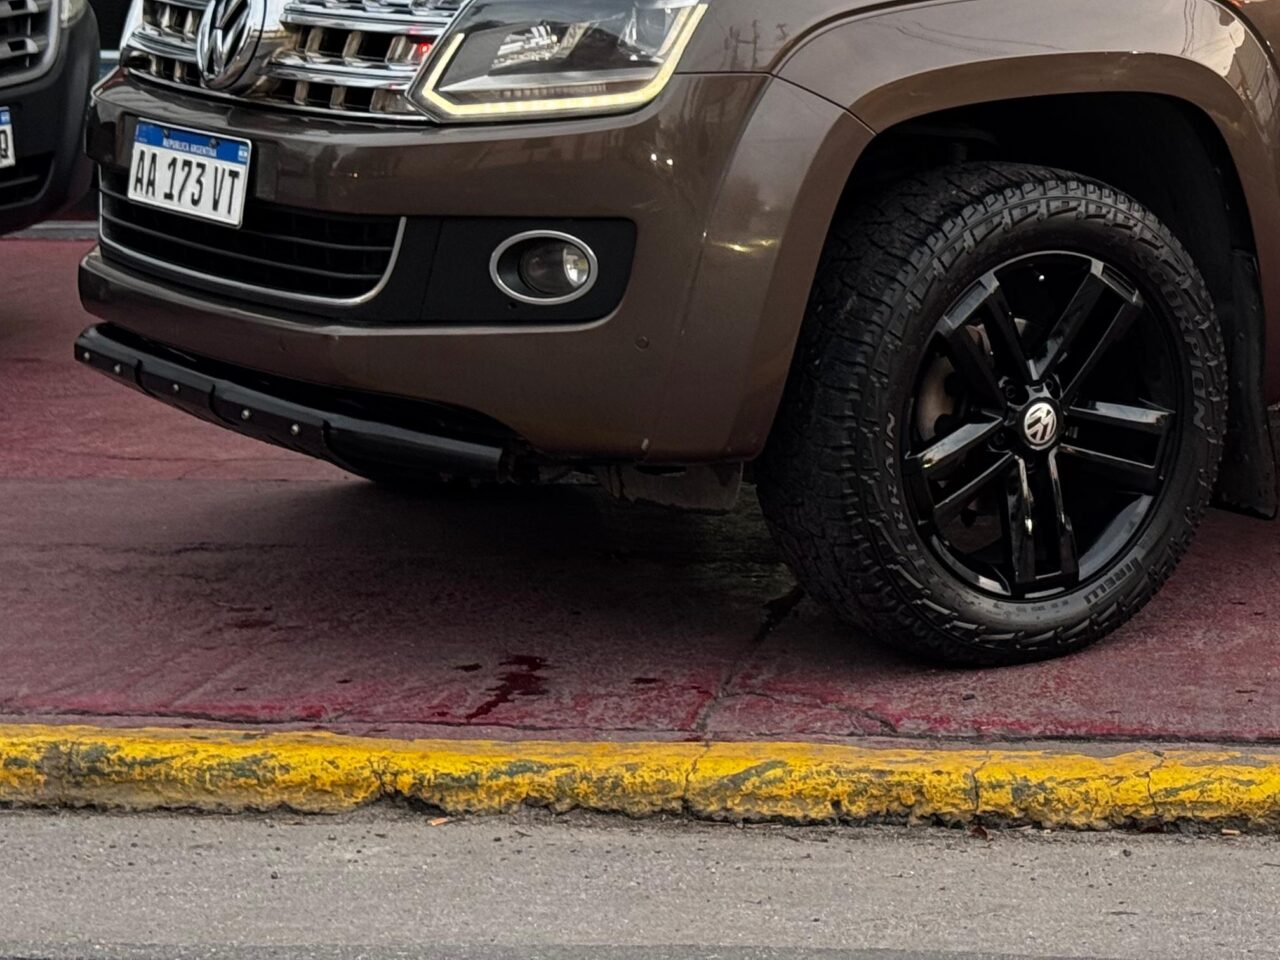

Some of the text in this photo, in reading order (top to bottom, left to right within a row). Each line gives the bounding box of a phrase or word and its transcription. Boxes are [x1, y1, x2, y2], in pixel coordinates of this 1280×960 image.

[134, 149, 240, 216] AA 173 VT
